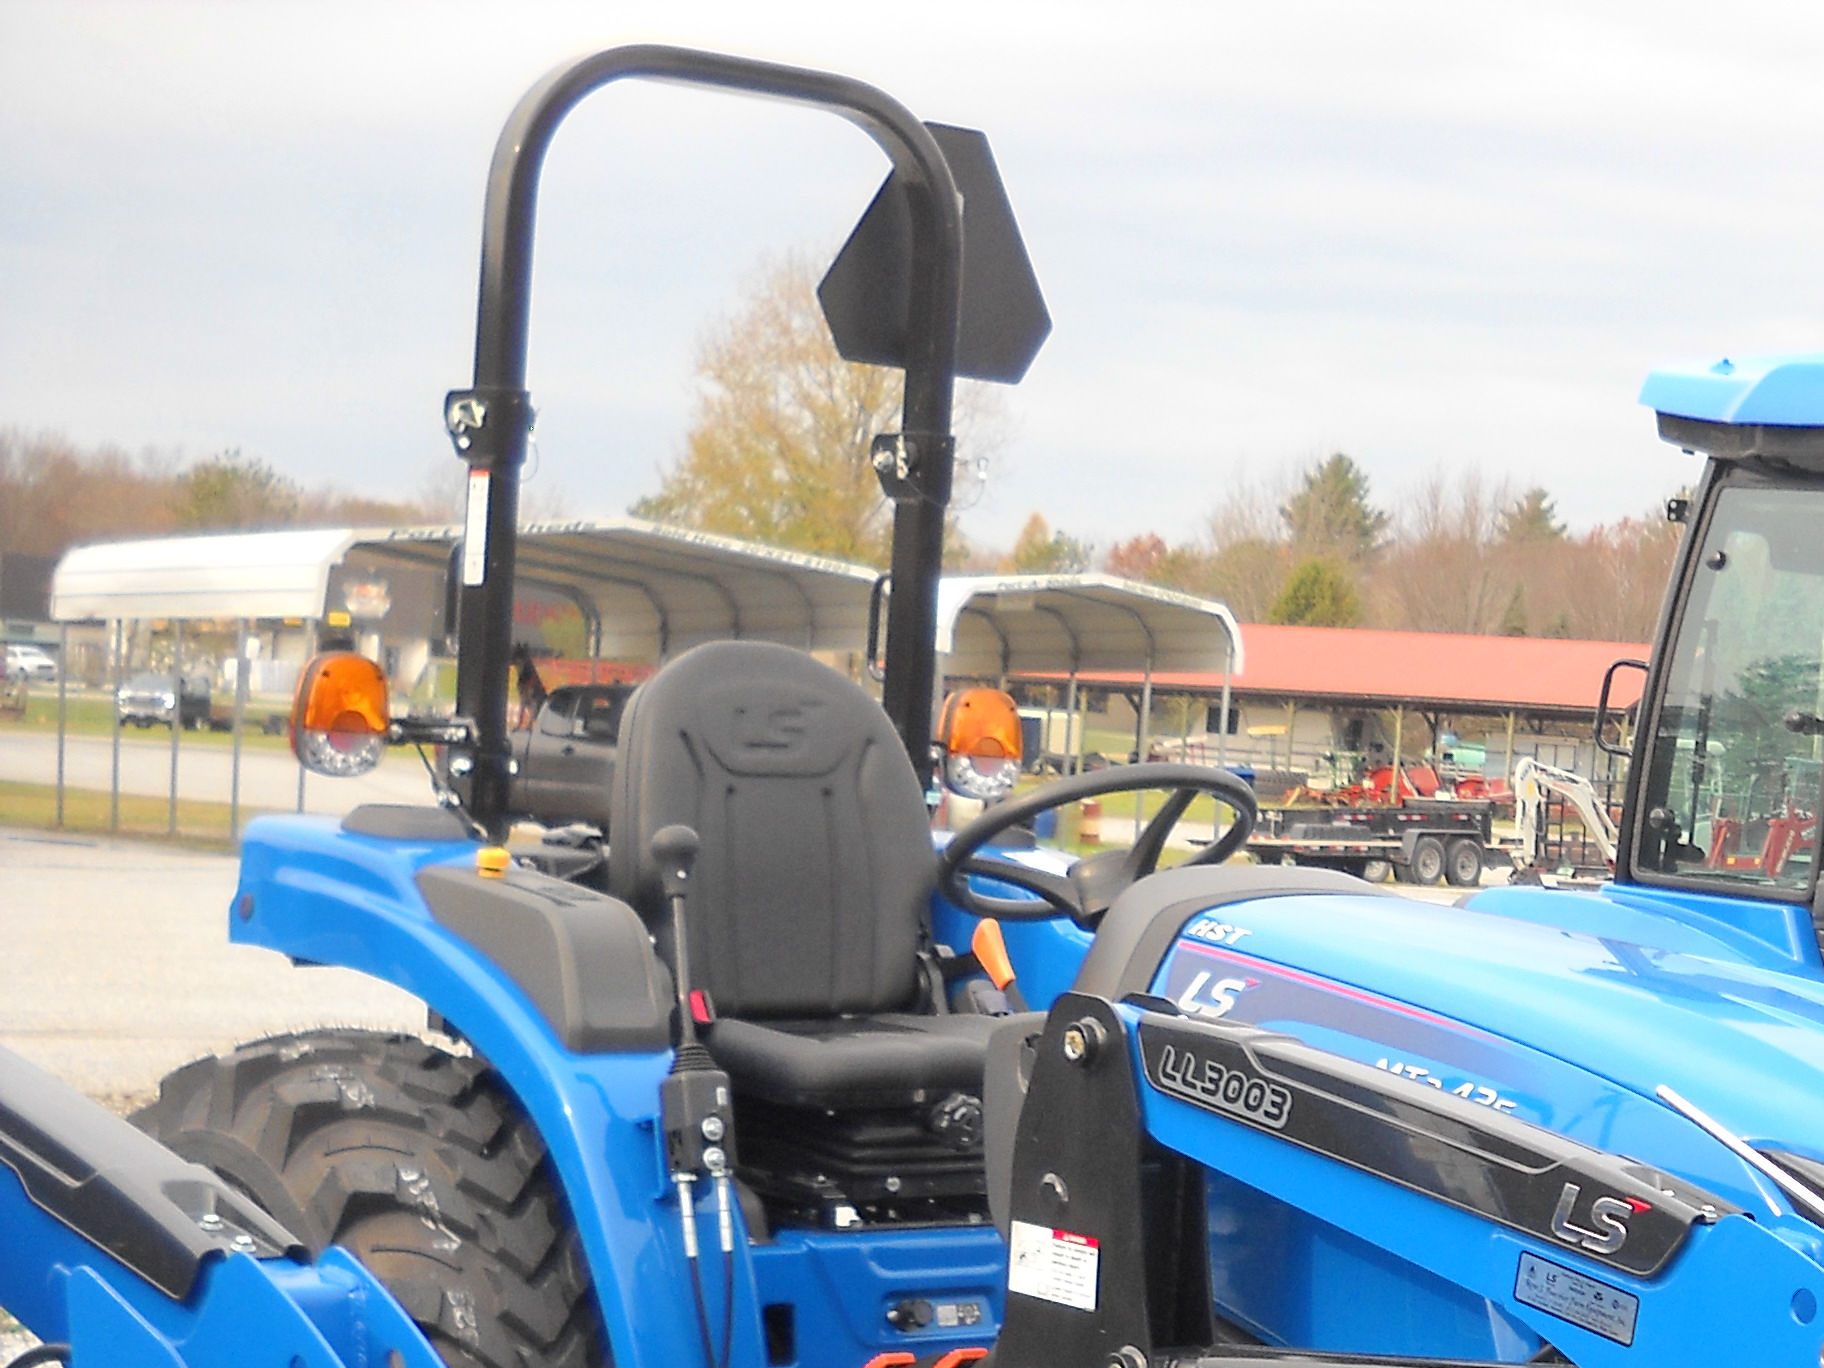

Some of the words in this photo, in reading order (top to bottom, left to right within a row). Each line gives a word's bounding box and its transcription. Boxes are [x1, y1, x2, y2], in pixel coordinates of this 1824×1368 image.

[1187, 918, 1254, 945] HST
[1177, 971, 1248, 1018] LS
[1158, 1045, 1293, 1129] LL3003
[1551, 1182, 1634, 1255] LS
